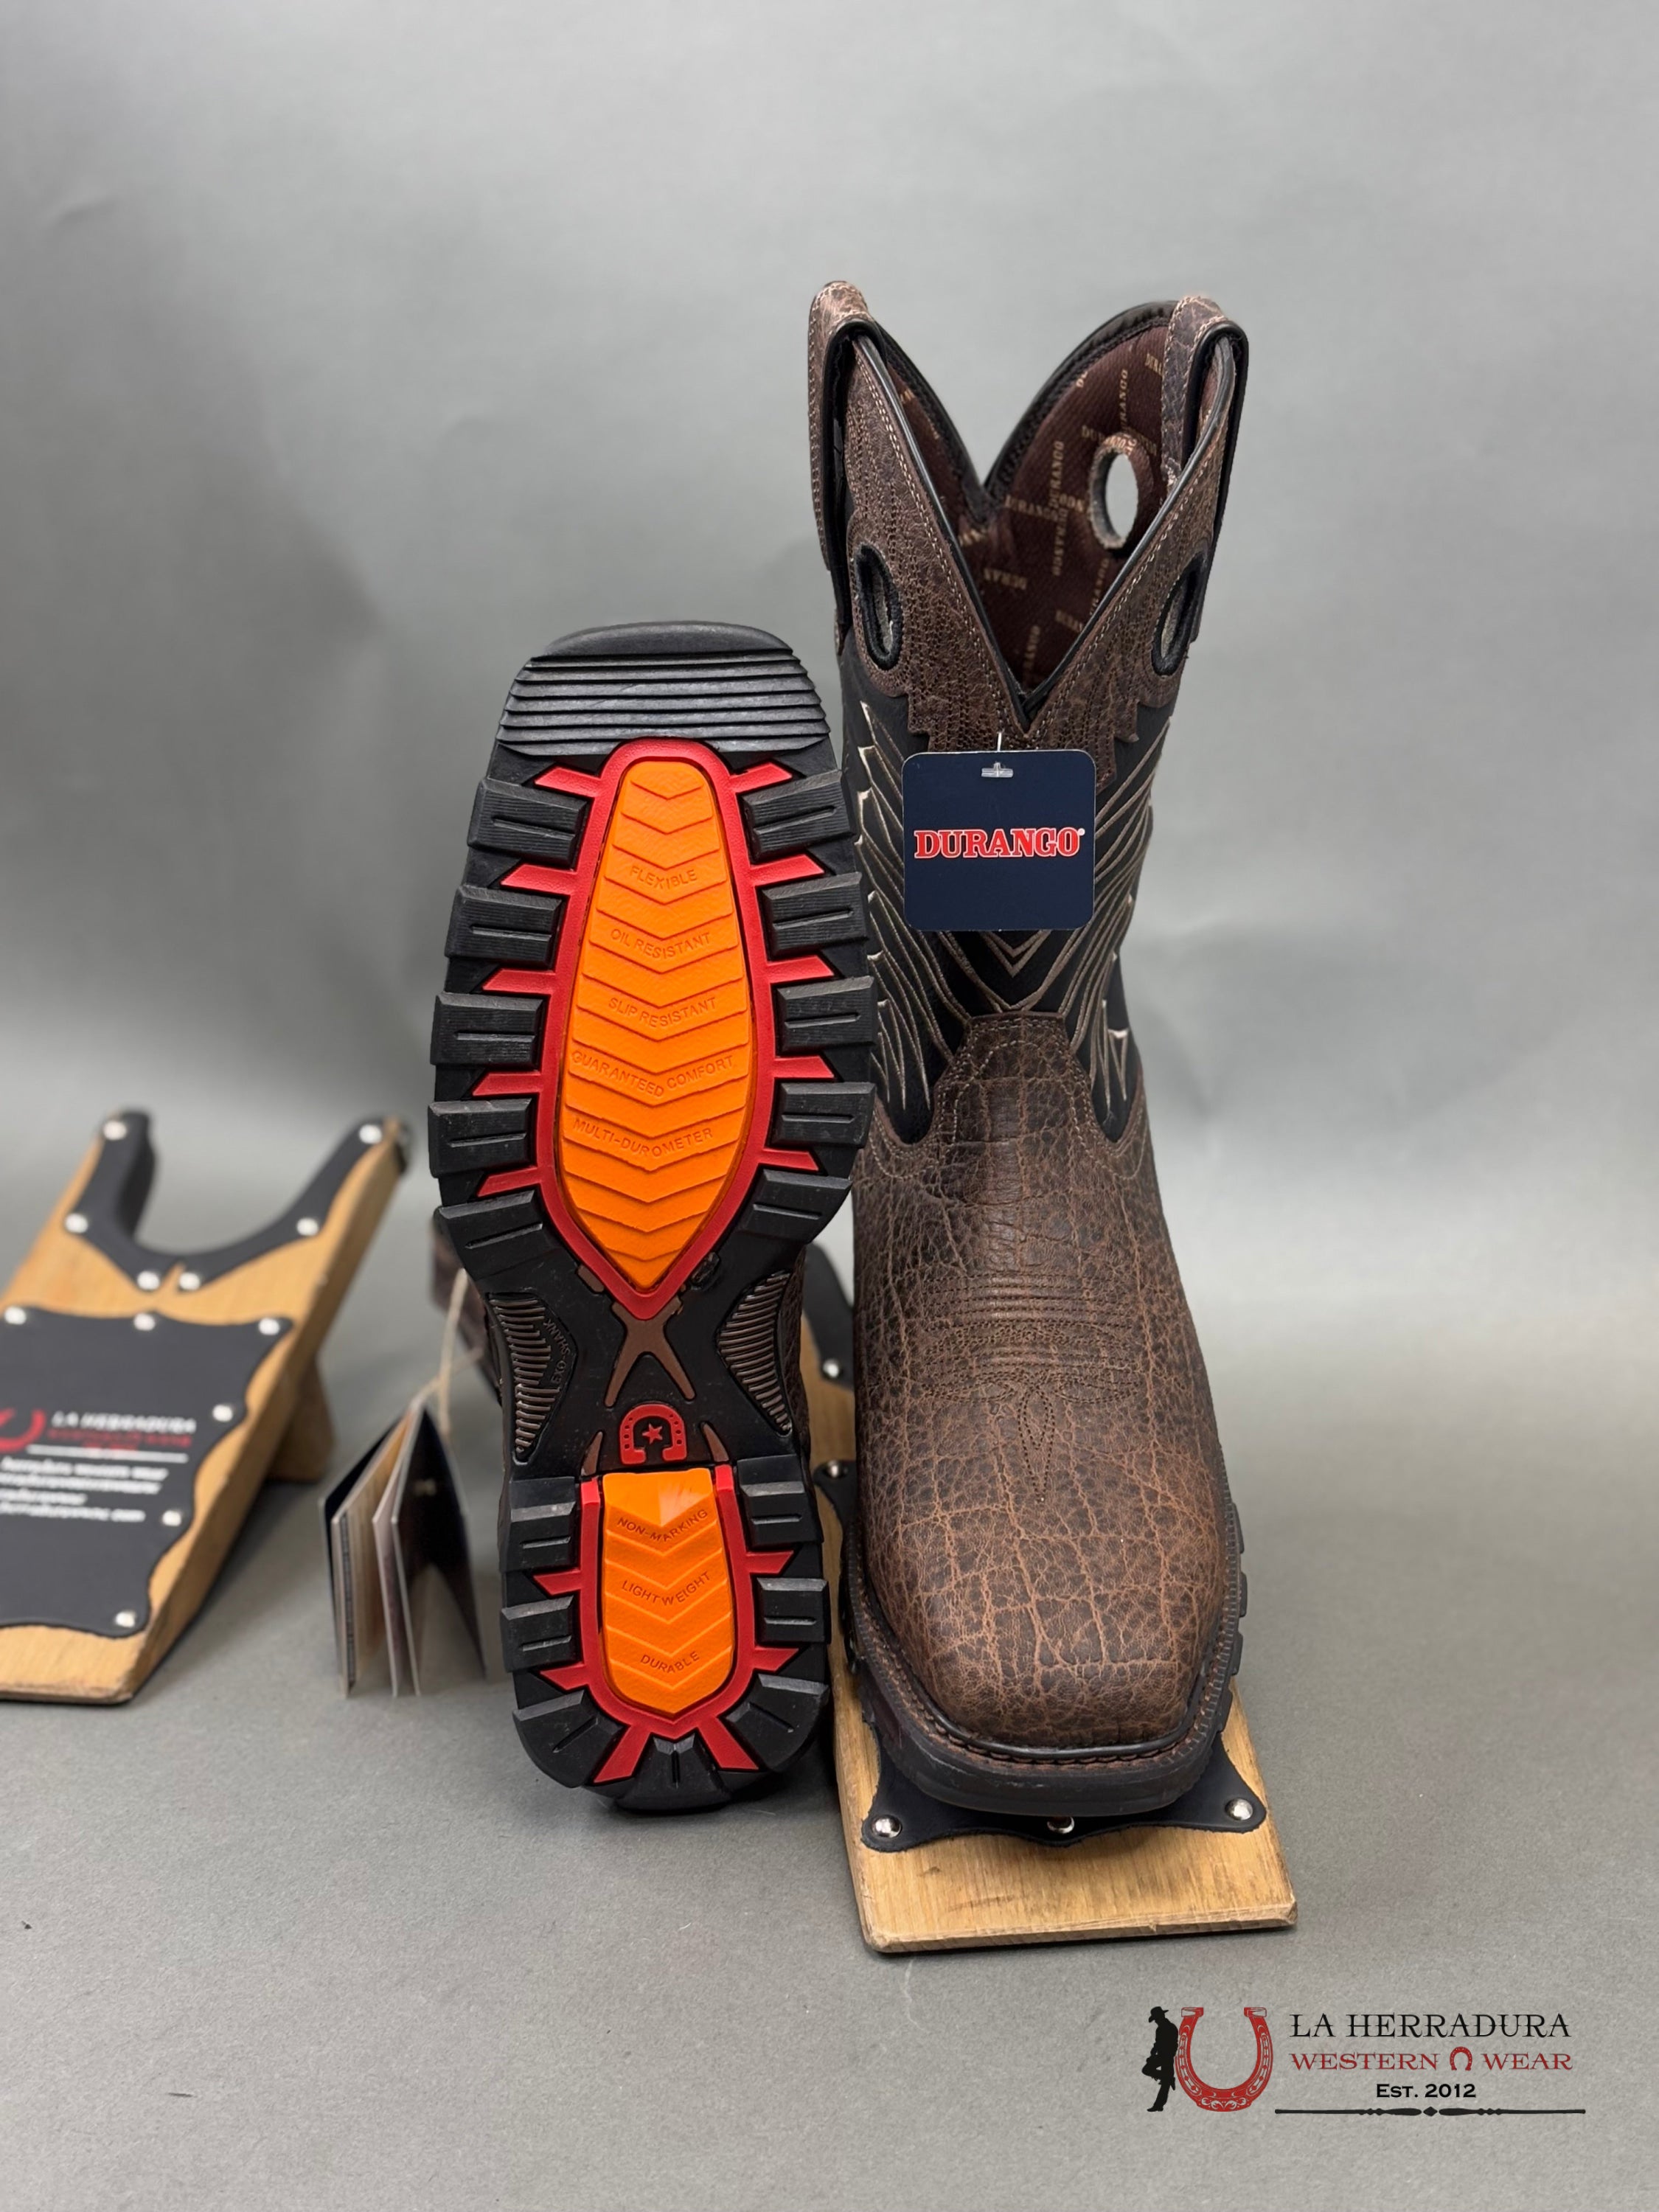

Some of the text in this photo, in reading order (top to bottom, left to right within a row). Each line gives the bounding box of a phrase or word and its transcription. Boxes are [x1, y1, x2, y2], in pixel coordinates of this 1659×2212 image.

[629, 866, 698, 890] FLEXIBLE
[611, 928, 711, 959] OIL RESISTANT
[608, 997, 717, 1027] SLIP RESISTANT
[571, 1049, 734, 1098] GUARANTEED COMFORT
[573, 1117, 713, 1158] MULTI-DUROMETER
[543, 1318, 571, 1384] EXO-SHANK
[617, 1509, 708, 1542] NON-MARKING
[622, 1571, 711, 1606] LIGHTWEIGHT
[641, 1651, 700, 1674] DURABLE
